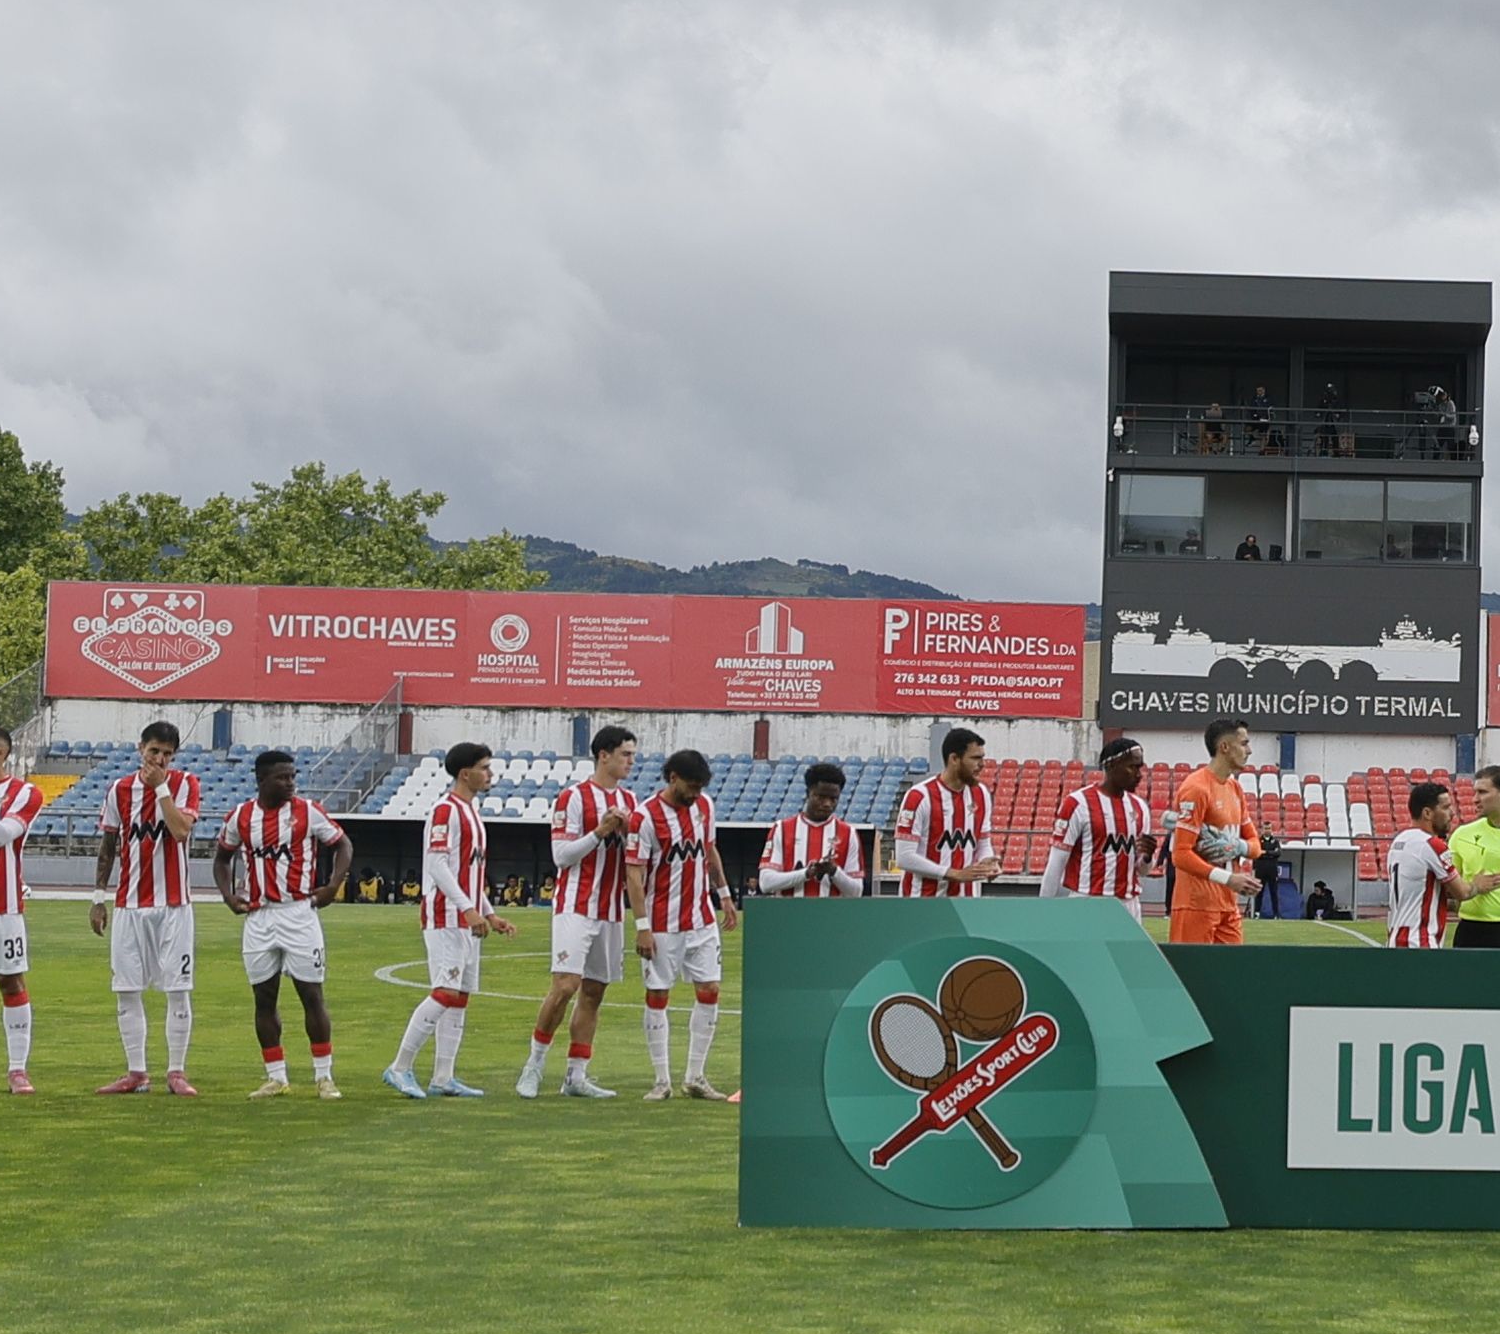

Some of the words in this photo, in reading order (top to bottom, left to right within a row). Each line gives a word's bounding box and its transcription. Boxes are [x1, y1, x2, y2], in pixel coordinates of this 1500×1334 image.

[116, 618, 231, 635] FRANCES
[268, 614, 457, 641] VITROCHAVES
[569, 616, 600, 625] Serviços
[602, 616, 648, 626] Hospitalares
[926, 612, 983, 632] PIRES
[988, 615, 1001, 632] &
[95, 637, 204, 660] CASINO
[592, 642, 628, 650] Operatório
[924, 634, 1049, 656] FERNANDES
[1052, 644, 1076, 656] LDA
[478, 653, 539, 666] HOSPITAL
[715, 656, 782, 669] ARMAZÉNS
[785, 659, 834, 671] EUROPA
[883, 658, 916, 666] COMÉRCIO
[922, 659, 963, 668] DISTRIBUIÇÃO
[1002, 662, 1035, 670] PRODUTOS
[1035, 663, 1074, 671] ALIMENTARES
[143, 662, 153, 671] DE
[567, 667, 601, 675] Medicina
[602, 668, 635, 676] Dentária
[736, 670, 755, 678] TUDO
[894, 673, 915, 684] 276
[917, 674, 937, 684] 342
[940, 674, 960, 685] 633
[970, 675, 1064, 688] PFLDA@SAPO.PT
[567, 677, 612, 686] Residência
[614, 678, 641, 687] Sénior
[765, 679, 821, 692] CHAVES
[727, 691, 758, 699] Telefone:
[896, 688, 913, 696] ALTO
[926, 689, 961, 697] TRINDADE
[967, 690, 997, 698] AVENIDA
[998, 690, 1022, 699] HERÓIS
[1034, 692, 1060, 700] CHAVES
[955, 699, 1000, 710] CHAVES
[1111, 690, 1209, 713] CHAVES
[1216, 689, 1349, 715] MUNICÍPIO
[1355, 695, 1461, 718] TERMAL
[4, 936, 24, 960] 33
[181, 954, 191, 975] 2
[1337, 1042, 1496, 1135] LIGA
